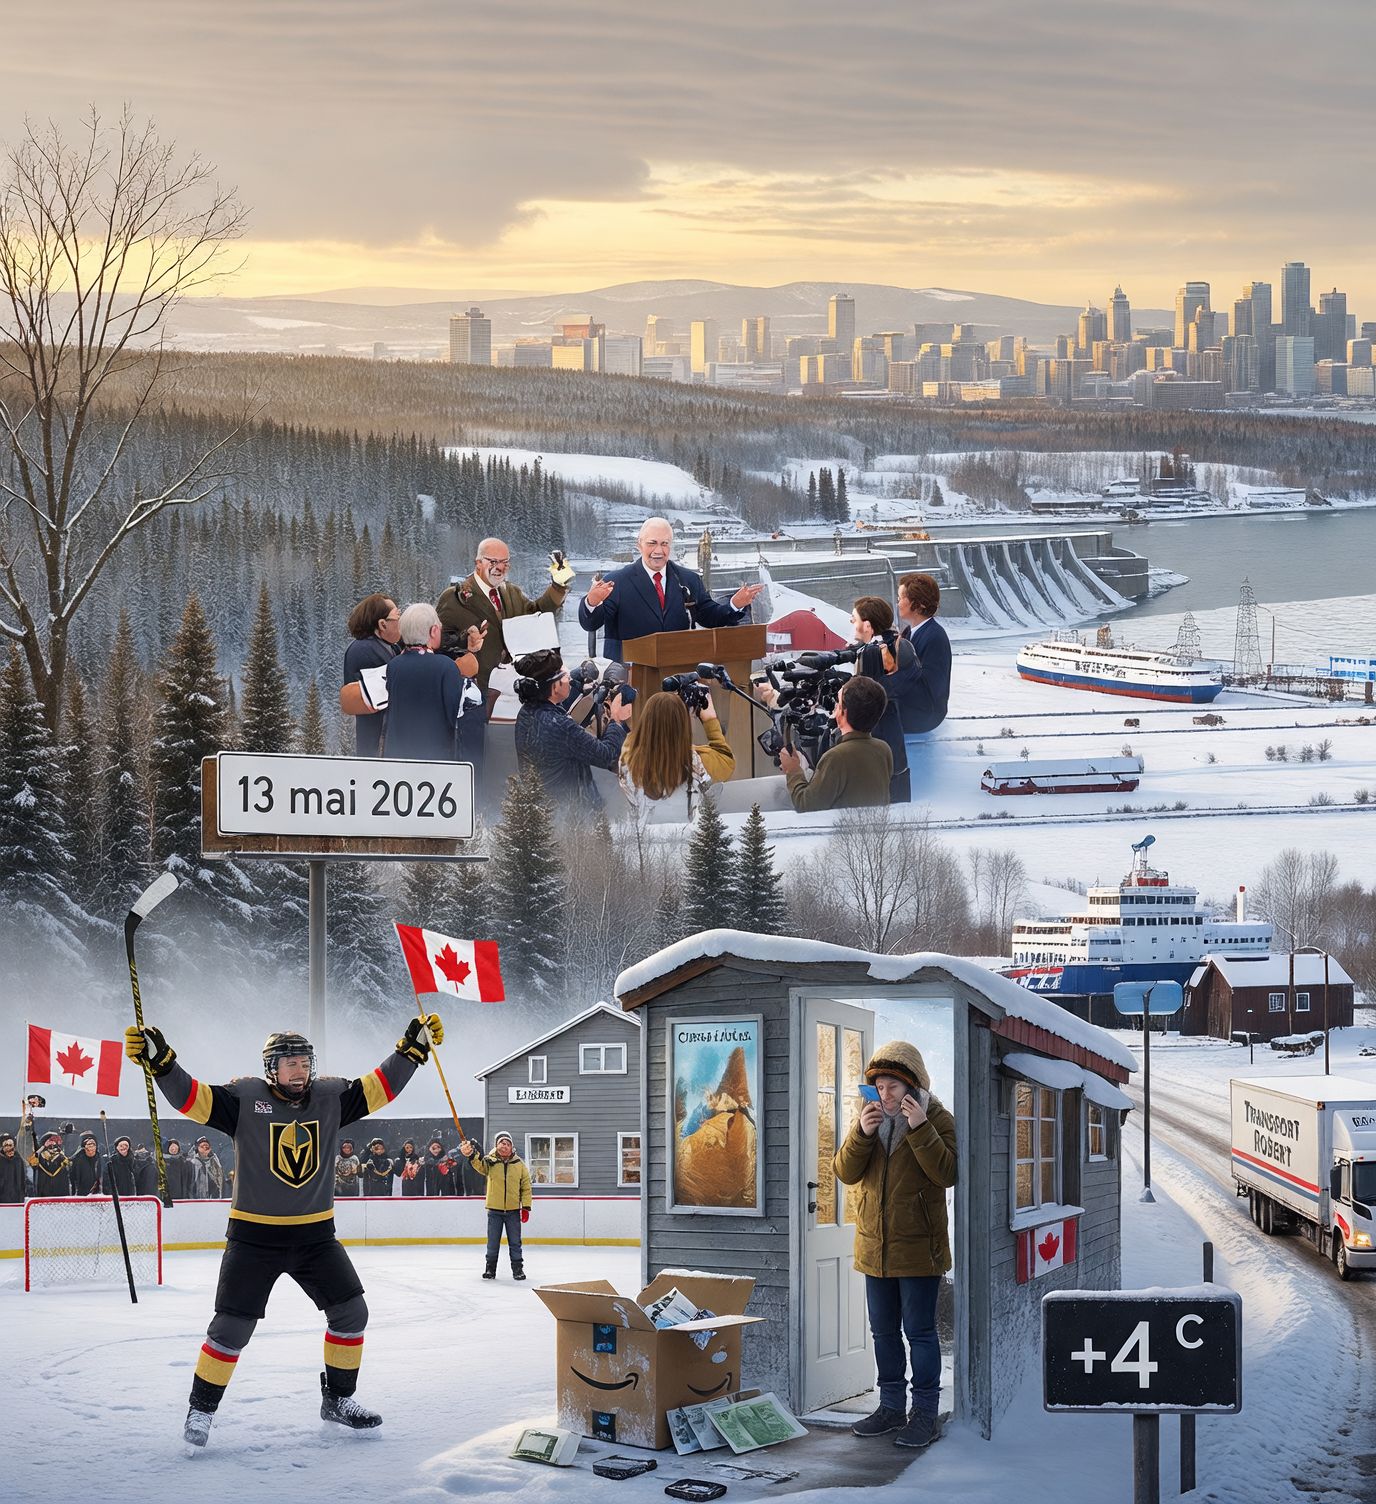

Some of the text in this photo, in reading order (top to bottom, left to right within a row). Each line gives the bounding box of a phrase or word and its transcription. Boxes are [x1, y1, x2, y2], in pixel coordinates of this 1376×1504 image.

[238, 775, 458, 819] 13 mai 2026
[1070, 1313, 1205, 1389] +4 C
